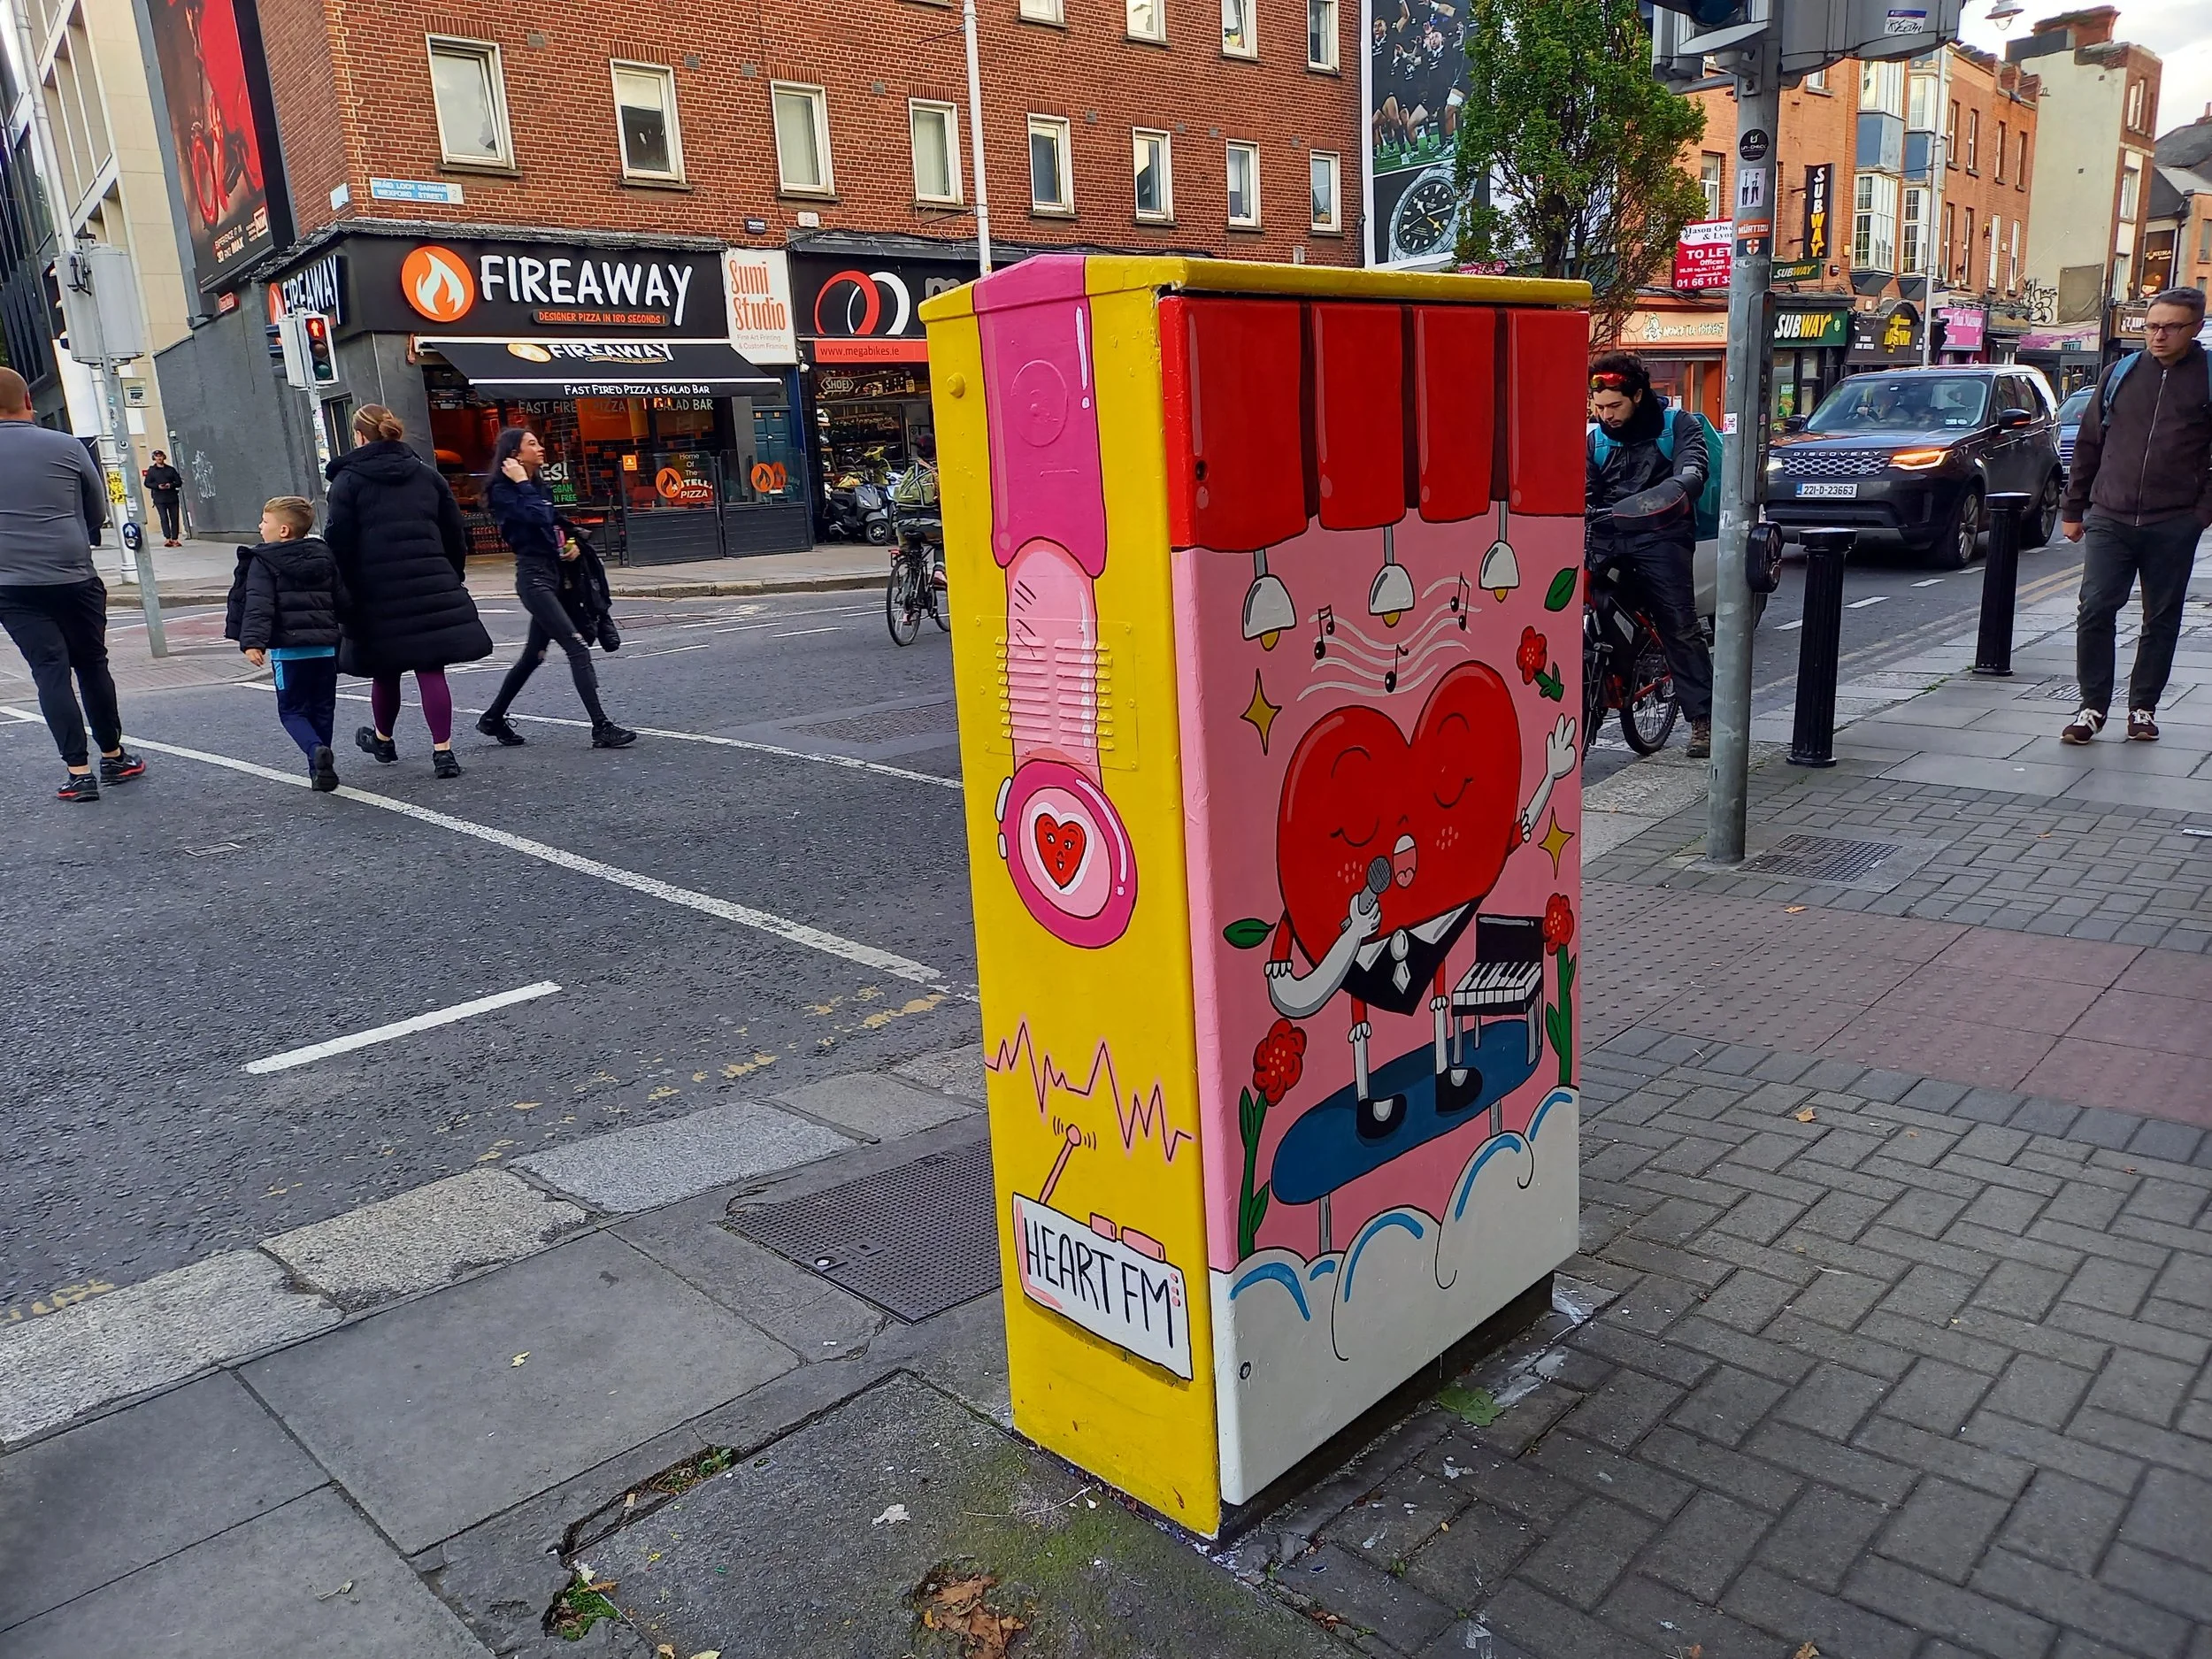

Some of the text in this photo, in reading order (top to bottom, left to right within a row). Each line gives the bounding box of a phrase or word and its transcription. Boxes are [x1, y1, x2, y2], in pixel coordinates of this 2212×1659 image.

[377, 188, 444, 201] WEXFORD STREET
[1810, 166, 1825, 257] SUBWAY
[1686, 247, 1732, 260] TO LET
[729, 259, 769, 295] Sumi
[1773, 265, 1816, 279] SUBWAY
[1676, 279, 1688, 288] 01
[1691, 277, 1704, 287] 66
[1707, 276, 1718, 285] 11
[281, 255, 341, 325] FIREAWAY
[480, 254, 693, 326] FIREAWAY
[539, 311, 577, 322] DESIGNER
[578, 312, 602, 322] PIZZA
[603, 313, 611, 323] IN
[612, 314, 626, 323] 180
[627, 315, 661, 324] SECONDS
[733, 296, 787, 331] Studio
[1773, 312, 1832, 339] SUBWAY
[547, 343, 675, 361] FIREAWAY
[819, 345, 900, 357] www.megabikes.ie
[564, 384, 591, 396] FAST
[624, 385, 653, 395] PIZZA
[654, 386, 660, 395] &
[661, 385, 691, 395] SALAD
[692, 385, 710, 395] BAR
[826, 379, 850, 390] SHOEI
[518, 401, 548, 414] FAST
[693, 398, 714, 411] BAR
[539, 462, 569, 481] ES!
[552, 484, 573, 494] EGAN
[680, 489, 709, 499] PIZZA
[1803, 485, 1855, 495] 221-D-23663
[561, 494, 578, 503] FREE
[1023, 1217, 1174, 1349] HEART FM
